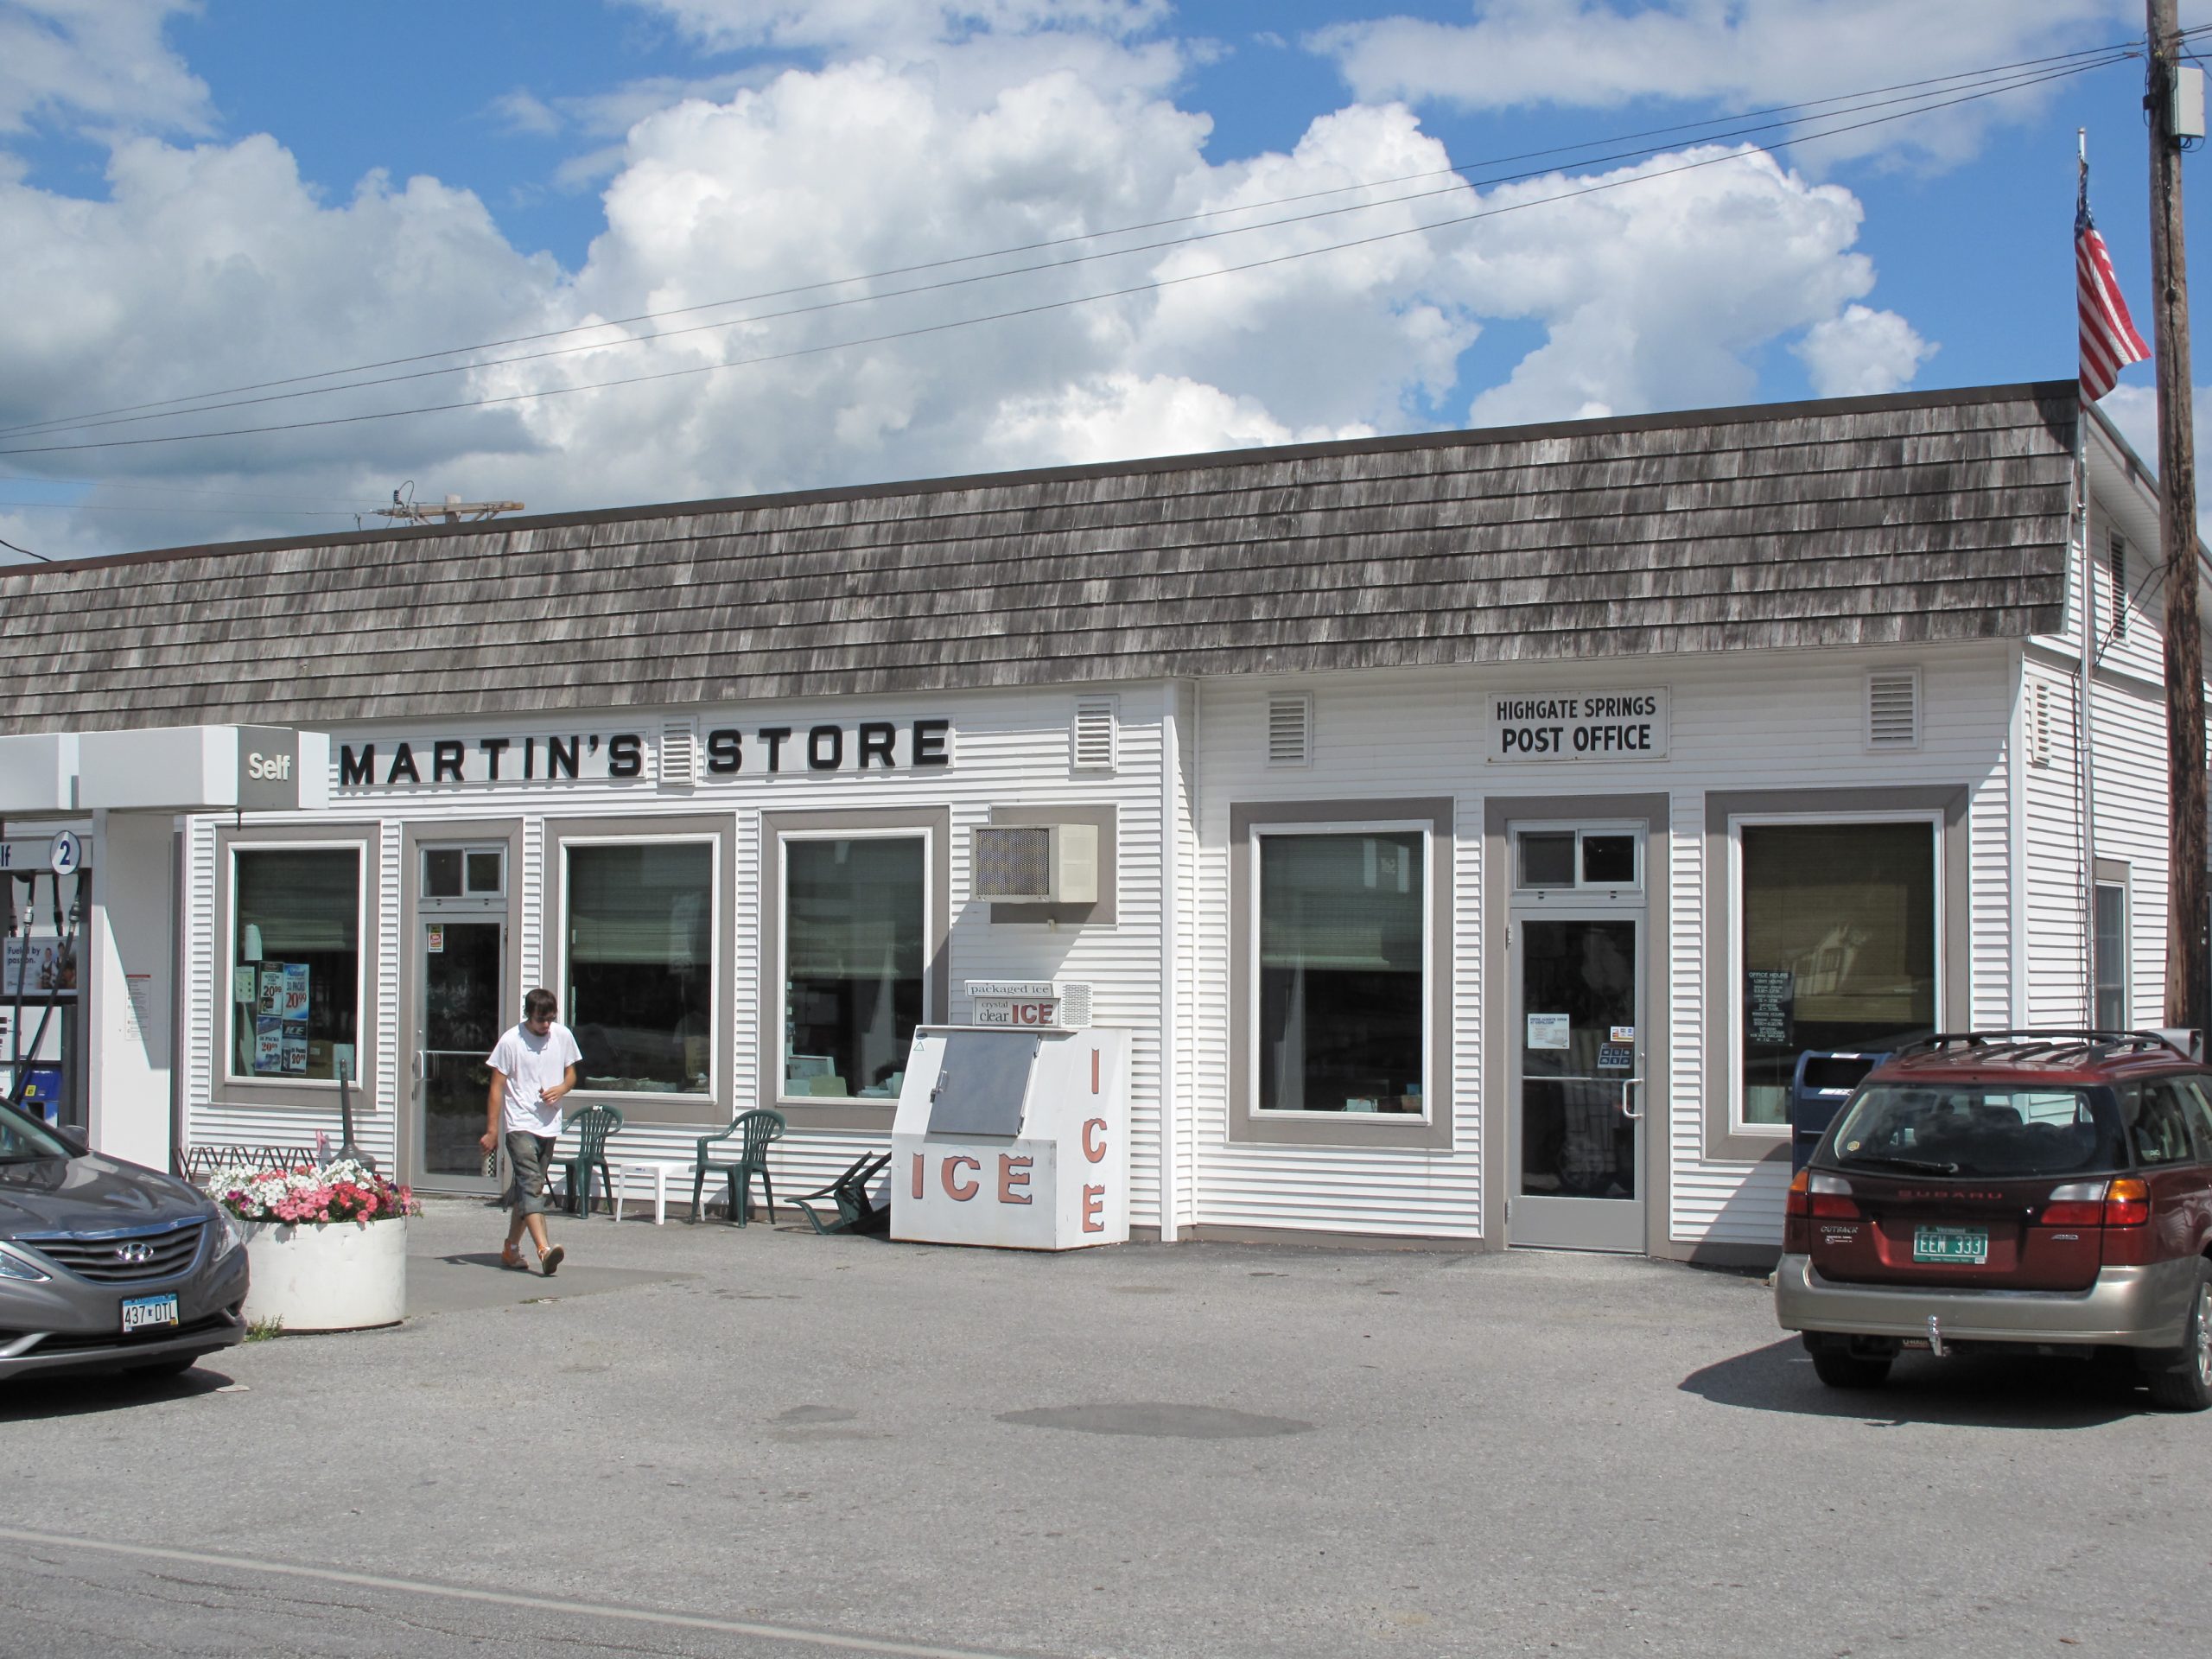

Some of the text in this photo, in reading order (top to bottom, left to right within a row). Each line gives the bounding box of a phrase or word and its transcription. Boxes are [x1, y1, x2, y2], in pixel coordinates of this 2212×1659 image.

[1497, 696, 1656, 720] HIGHGATE SPRINGS
[1502, 724, 1651, 753] POST OFFICE
[340, 720, 949, 785] MARTIN'S STORE
[248, 752, 291, 781] Self
[60, 840, 71, 866] 2
[970, 984, 1028, 995] packaged
[979, 1003, 1053, 1025] clear ICE
[912, 1153, 1033, 1205] ICE
[1897, 1190, 2003, 1199] SUBARU
[1920, 1235, 1981, 1255] EEM 333
[125, 1302, 176, 1325] 437 DTL
